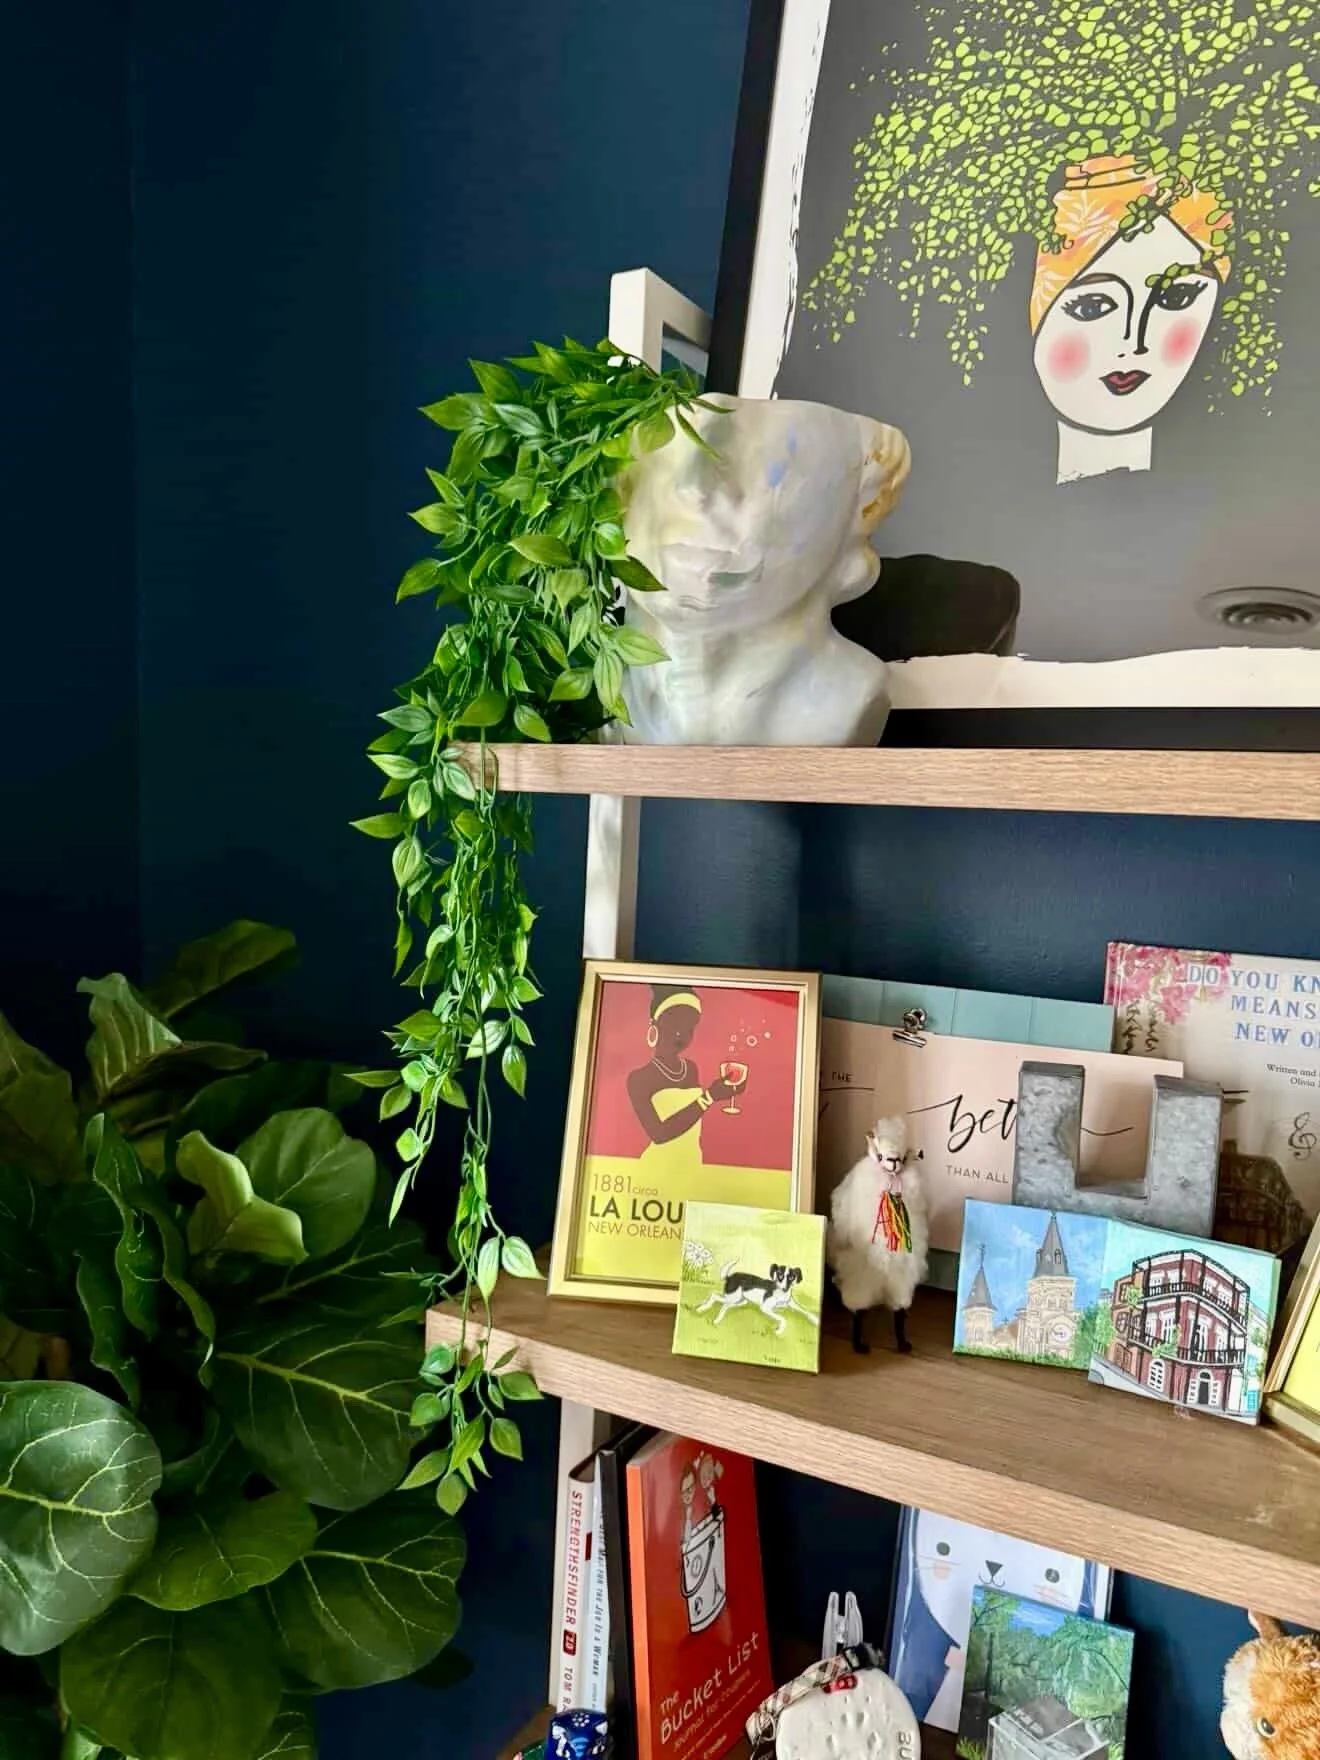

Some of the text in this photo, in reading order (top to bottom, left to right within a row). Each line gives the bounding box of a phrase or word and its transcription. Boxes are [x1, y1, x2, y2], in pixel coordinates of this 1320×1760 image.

[1189, 965, 1220, 985] DO
[1230, 969, 1279, 991] YOU
[1231, 995, 1317, 1020] MEANS
[1235, 1022, 1320, 1049] NEW O
[831, 1071, 853, 1083] THE
[1266, 1063, 1317, 1077] Written and
[593, 1173, 659, 1197] 1881 circa
[945, 1165, 1009, 1184] THAN ALL
[589, 1195, 684, 1225] LA LOU
[588, 1221, 685, 1241] NEW ORLEAN
[565, 1489, 583, 1625] STRENGTHSFINDER
[563, 1667, 573, 1692] TOM
[661, 1667, 722, 1745] Bucket
[728, 1631, 759, 1675] List
[660, 1690, 680, 1715] The
